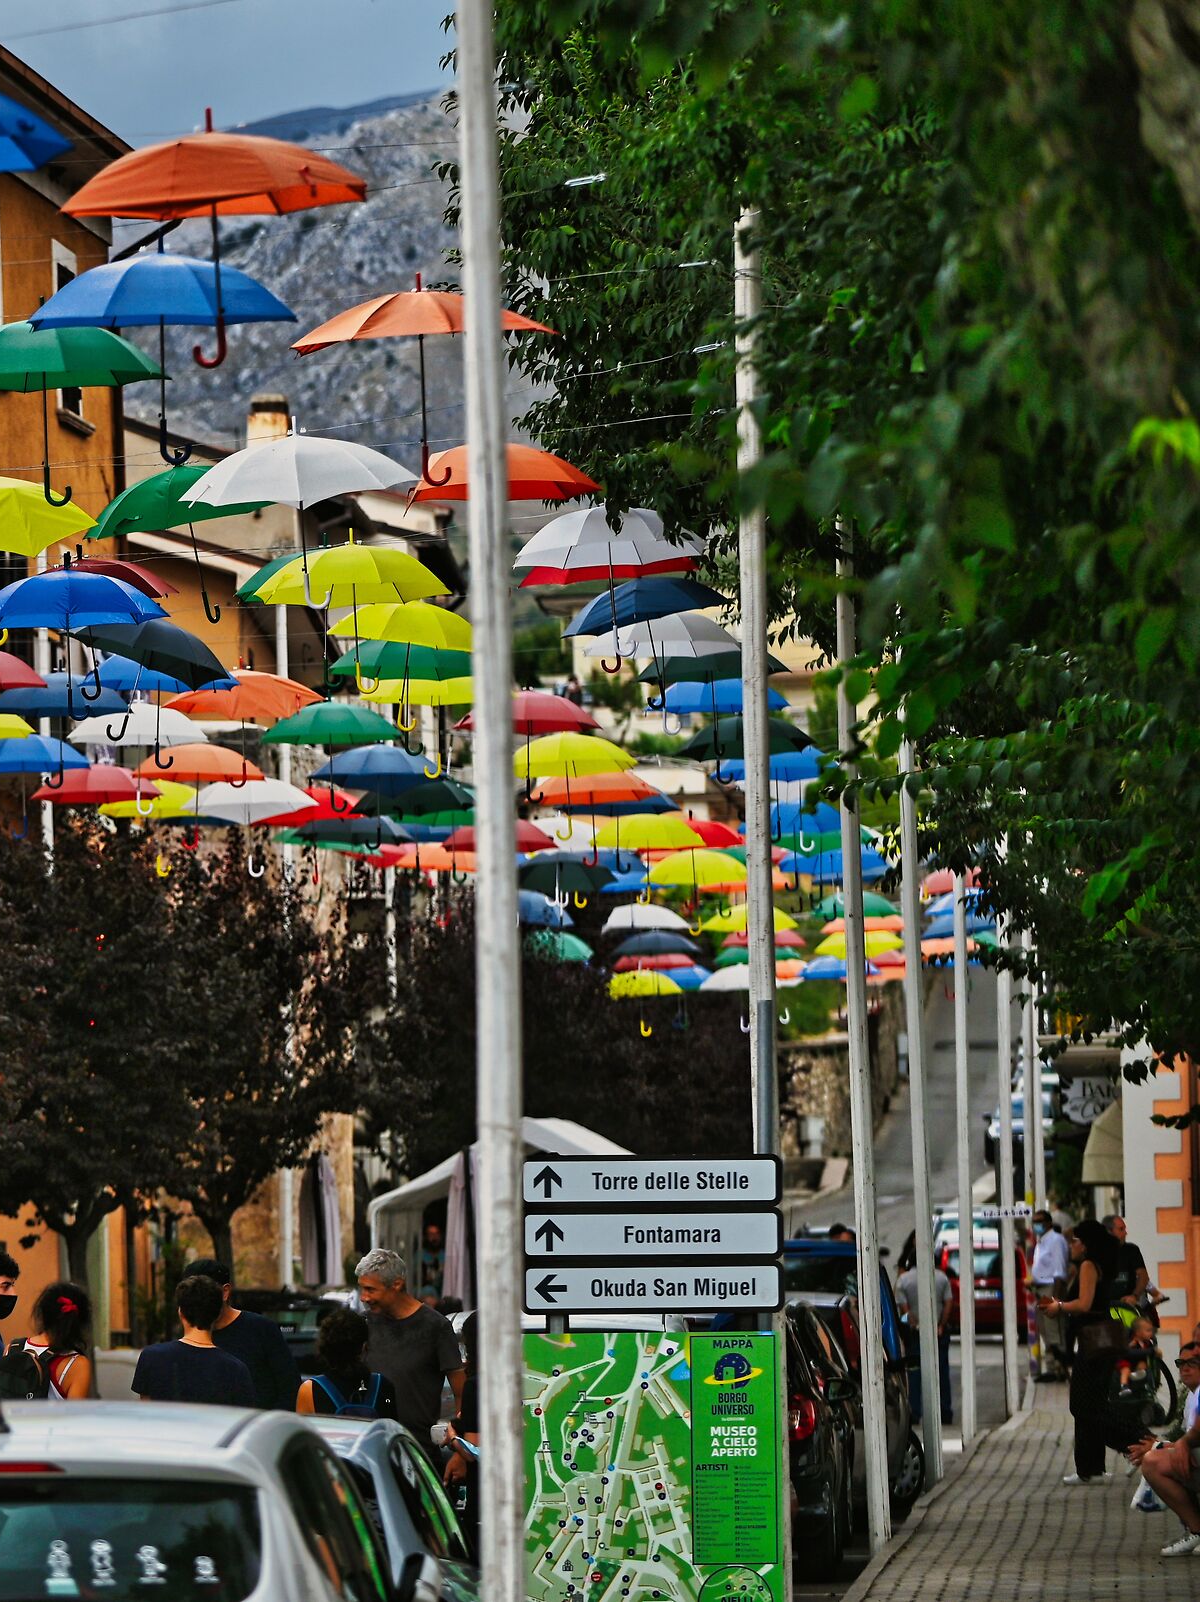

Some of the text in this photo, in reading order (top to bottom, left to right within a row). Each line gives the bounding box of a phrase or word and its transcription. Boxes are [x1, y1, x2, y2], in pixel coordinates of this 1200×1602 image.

[591, 1171, 750, 1190] Torre delle Stelle
[624, 1225, 721, 1244] Fontamara
[590, 1277, 757, 1300] Okuda San Miguel
[712, 1339, 754, 1349] MAPPA
[718, 1392, 748, 1403] BORGO
[711, 1404, 755, 1416] UNIVERSO
[710, 1426, 757, 1437] MUSEO
[711, 1437, 757, 1447] A CIELO
[711, 1447, 757, 1457] APERTO
[696, 1463, 729, 1471] ARTISTI
